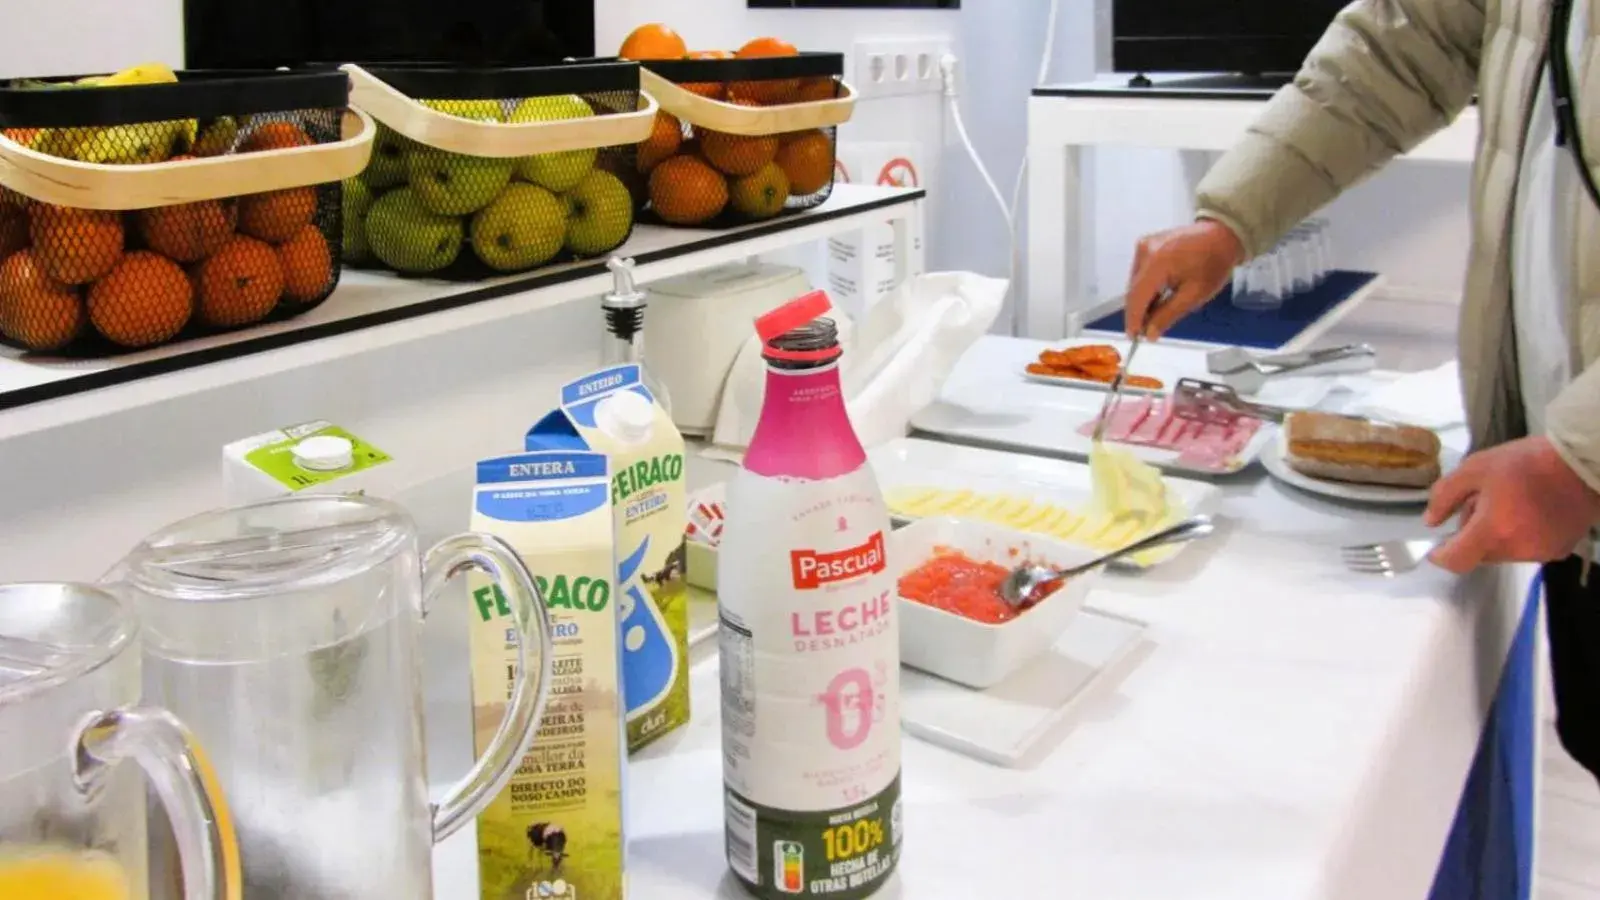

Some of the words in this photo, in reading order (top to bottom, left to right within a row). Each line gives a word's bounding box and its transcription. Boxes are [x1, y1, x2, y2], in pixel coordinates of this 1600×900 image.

[578, 373, 624, 396] ENTEIRO
[508, 461, 576, 478] ENTERA
[625, 493, 667, 518] ENTEIRO
[800, 539, 883, 579] Pascual
[472, 574, 610, 621] FERACO
[792, 589, 890, 636] LECHE
[505, 623, 578, 642] EIRO
[552, 685, 582, 695] ALEGA
[568, 747, 584, 759] da
[546, 759, 585, 772] TERRA
[511, 780, 565, 793] DIRECTO
[568, 777, 586, 788] DO
[511, 792, 543, 803] NOSO
[545, 788, 586, 800] CAMPO
[822, 817, 883, 860] 100%
[830, 856, 866, 877] HECHA
[810, 877, 848, 894] OTRAS
